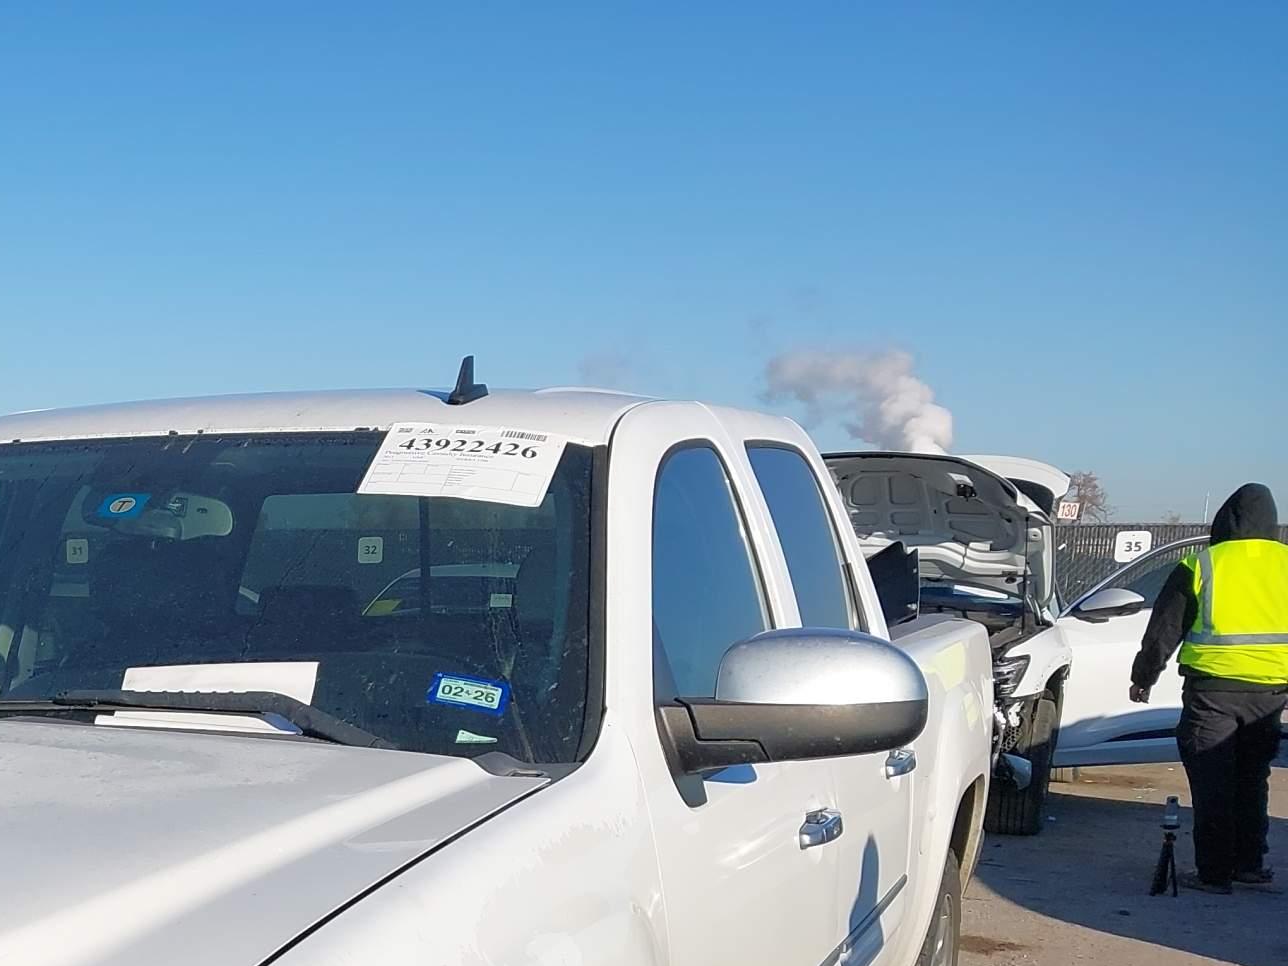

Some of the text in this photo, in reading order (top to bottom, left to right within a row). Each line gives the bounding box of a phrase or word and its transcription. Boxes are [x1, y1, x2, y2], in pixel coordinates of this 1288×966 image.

[398, 437, 539, 459] 43922426
[1061, 503, 1077, 518] 130
[363, 545, 378, 555] 32
[1124, 541, 1143, 552] 35
[441, 684, 496, 703] 02 26
